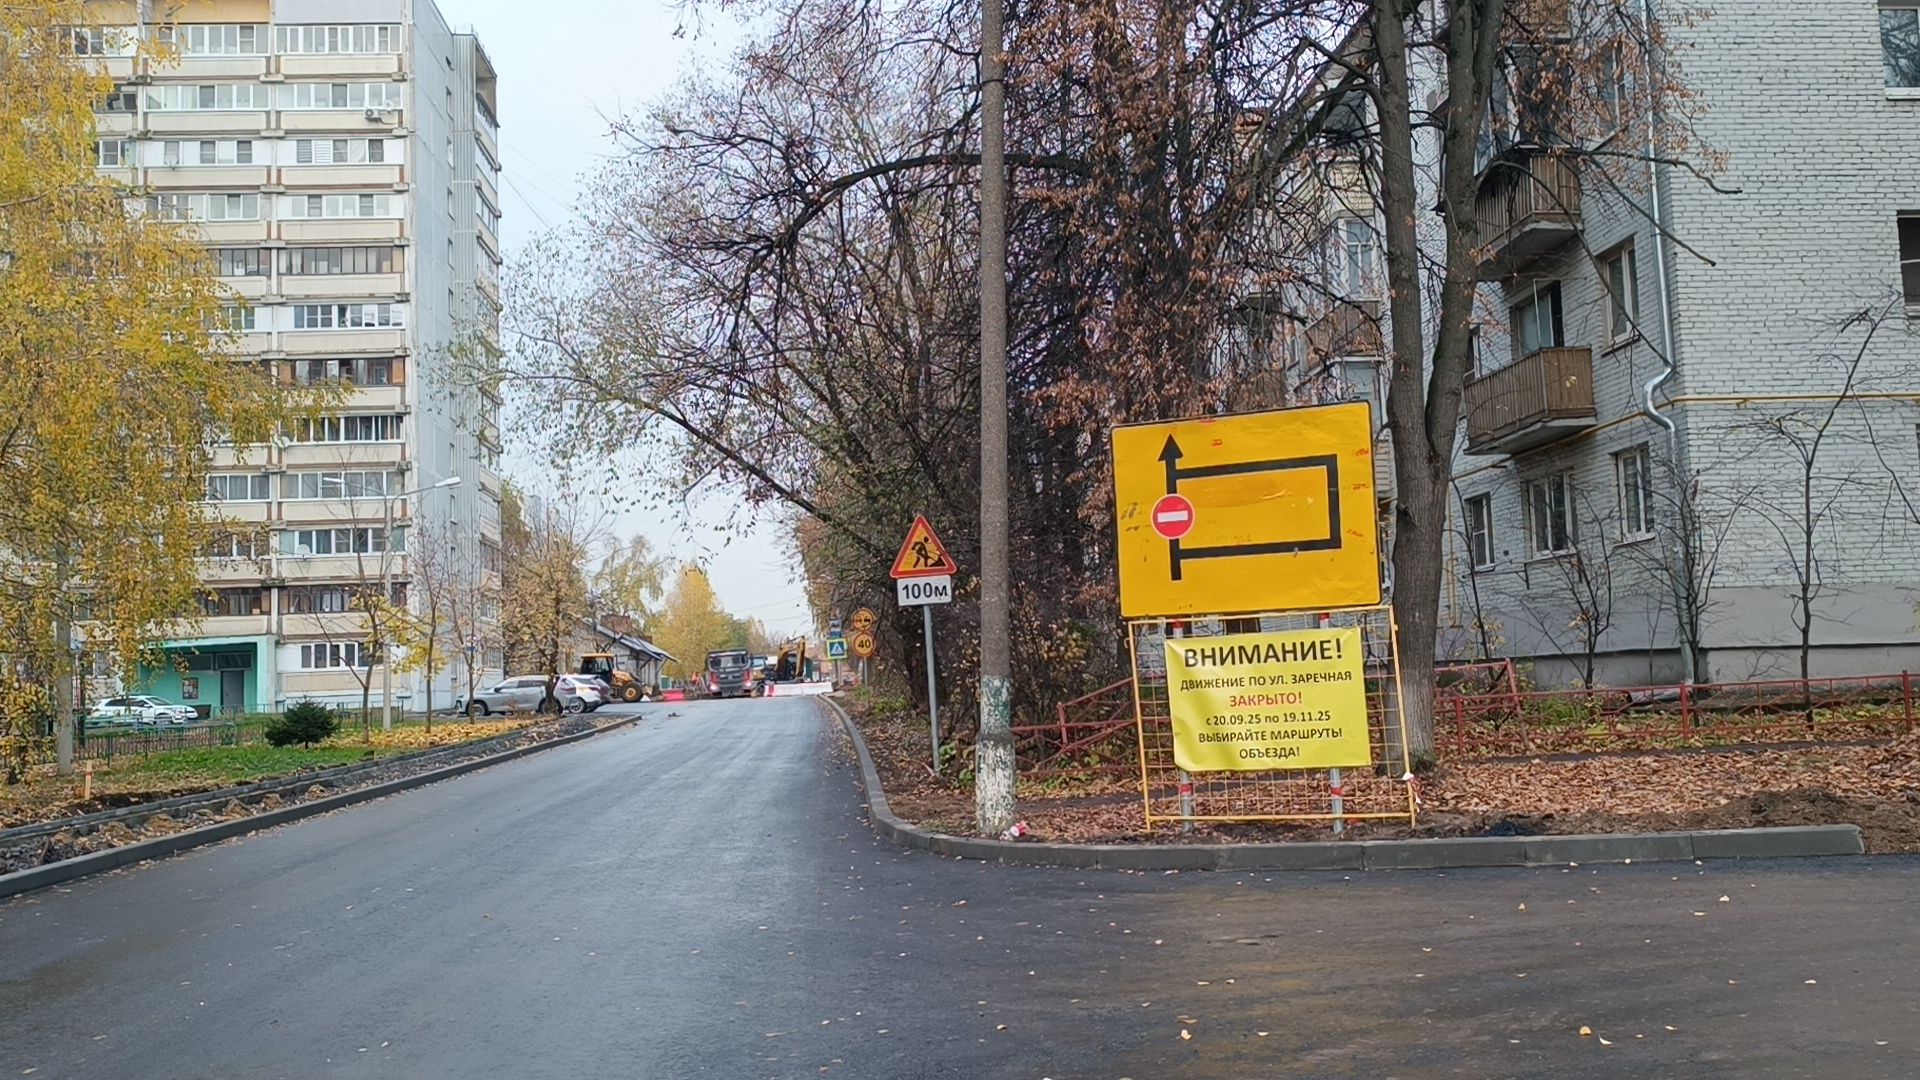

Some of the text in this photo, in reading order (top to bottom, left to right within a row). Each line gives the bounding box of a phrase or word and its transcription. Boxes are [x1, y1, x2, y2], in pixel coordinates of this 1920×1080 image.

[858, 638, 871, 649] 40
[1184, 638, 1342, 668] ВНИМАНИЕ!
[1181, 671, 1352, 692] ДВИЖЕНИЕ ПО УЛ. ЗАРЕЧНАЯ
[1229, 692, 1302, 707] ЗАКРЫТО!
[1206, 710, 1331, 726] с 20.09.25 по 19.11.25
[1199, 729, 1267, 743] ВЫБИРАЙТЕ
[1239, 746, 1300, 760] ОБЪЕЗДА!
